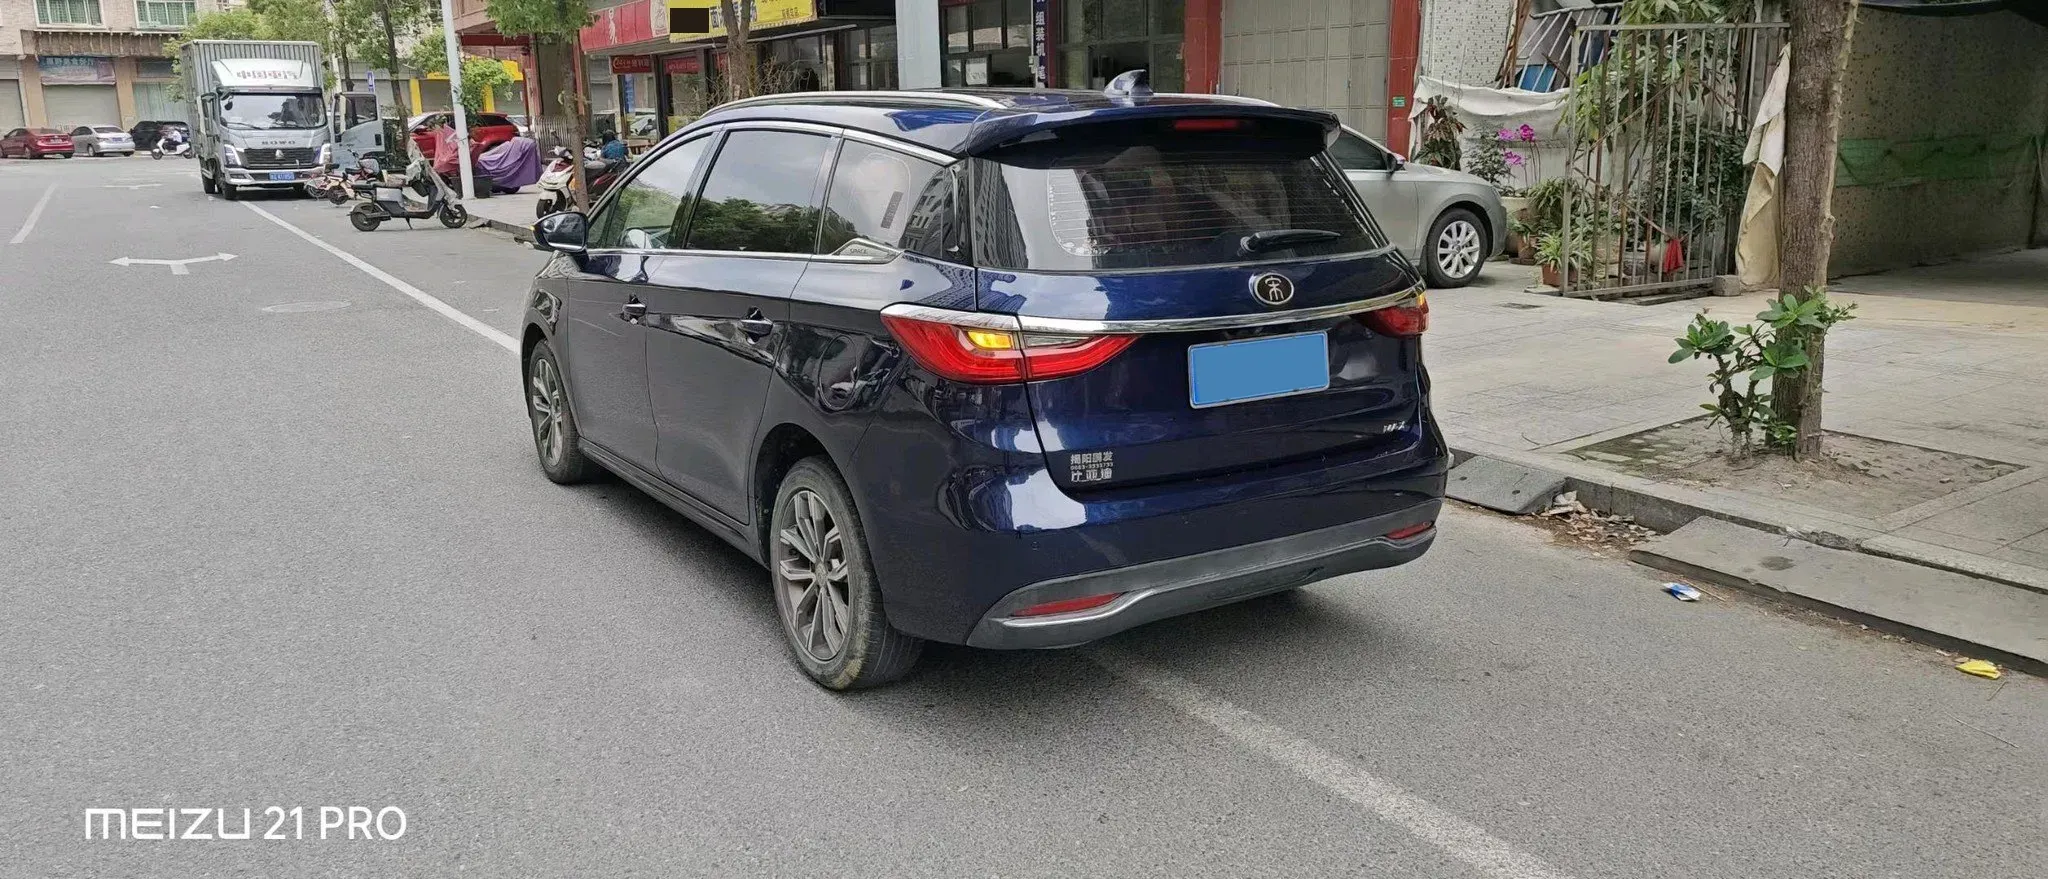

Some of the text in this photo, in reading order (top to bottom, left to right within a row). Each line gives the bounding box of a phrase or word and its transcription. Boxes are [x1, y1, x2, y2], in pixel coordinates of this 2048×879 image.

[1035, 11, 1046, 57] 组装机
[1070, 468, 1113, 482] 比亚迪
